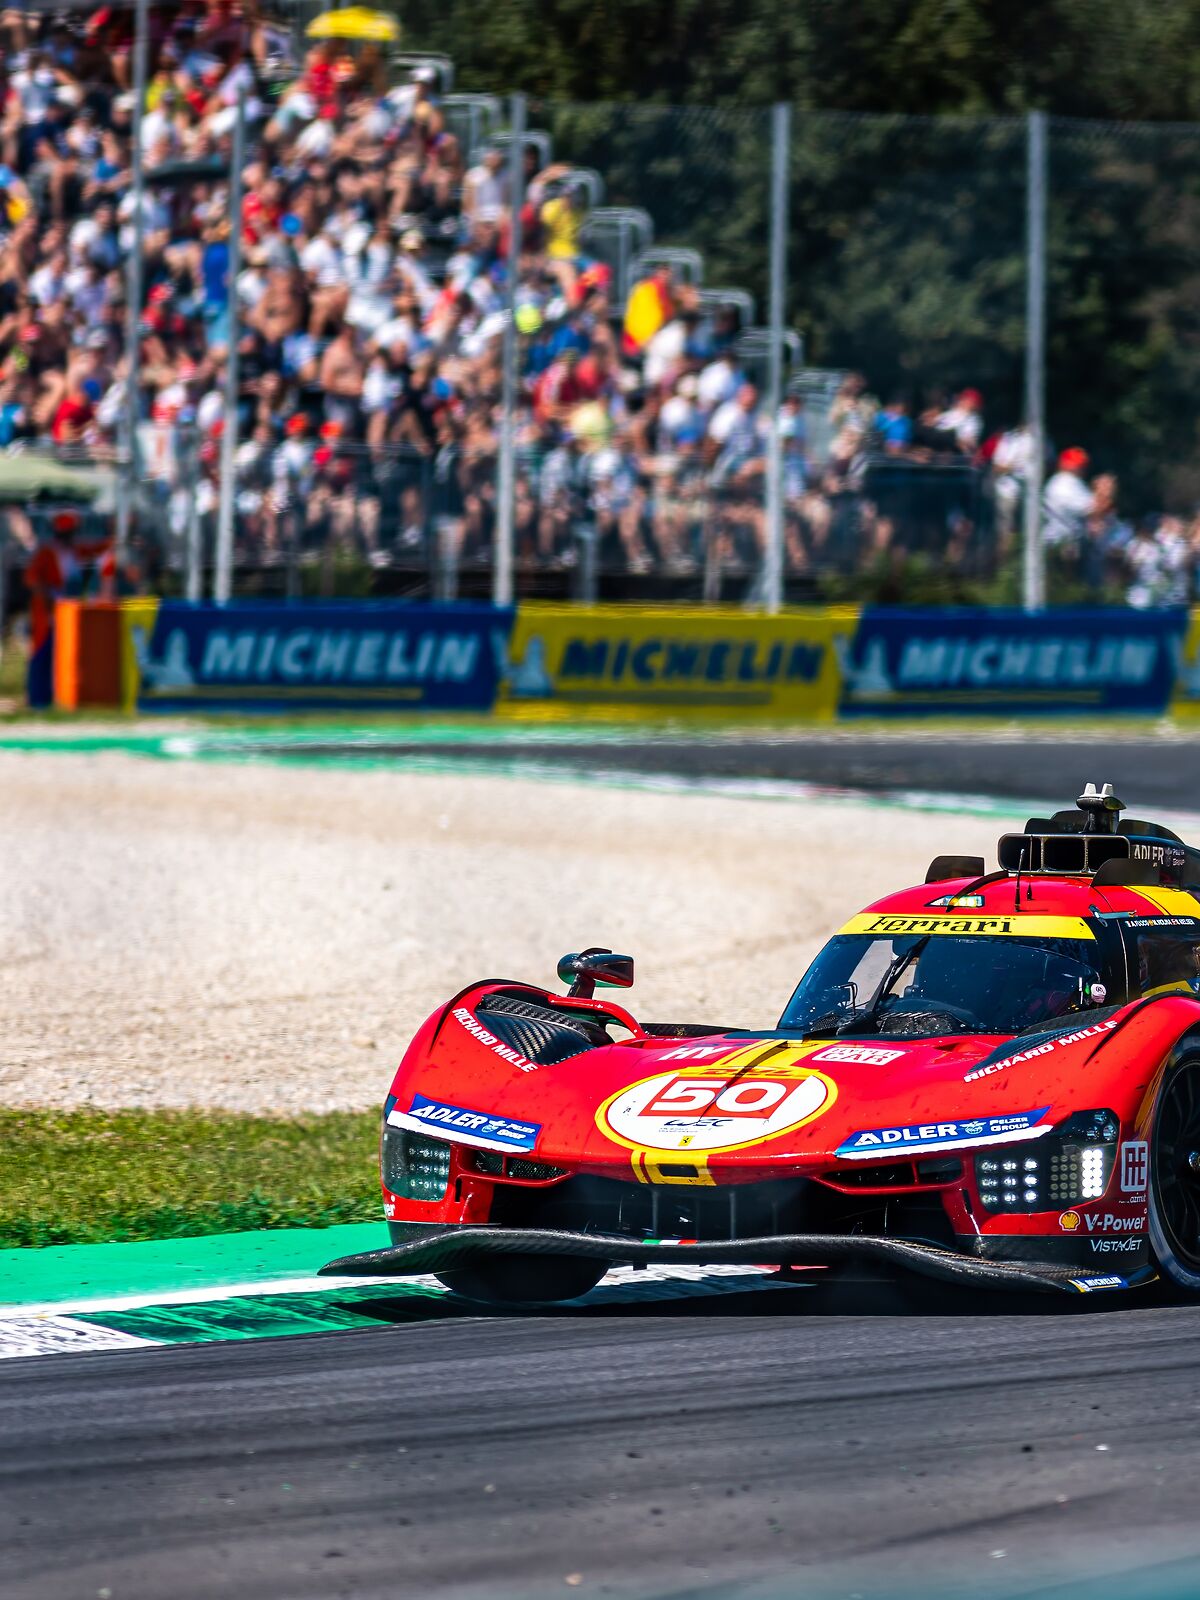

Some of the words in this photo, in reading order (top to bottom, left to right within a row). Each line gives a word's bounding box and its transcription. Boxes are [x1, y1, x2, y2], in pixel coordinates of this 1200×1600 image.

[204, 629, 482, 681] MICHELIN
[559, 636, 824, 684] MICHELIN
[901, 636, 1157, 684] MICHELIN
[863, 916, 1016, 933] Ferrari
[452, 1008, 497, 1046] RICHARD
[491, 1044, 538, 1072] MILLE
[963, 1042, 1055, 1083] RICHARD
[1058, 1020, 1118, 1046] MILLE
[820, 1052, 888, 1063] CAR
[650, 1080, 787, 1113] 50
[408, 1105, 488, 1129] ADLER
[990, 1123, 1030, 1132] GROUP
[854, 1123, 957, 1147] ADLER
[1084, 1213, 1146, 1231] V-Power
[1084, 1276, 1123, 1287] MICHELIN
